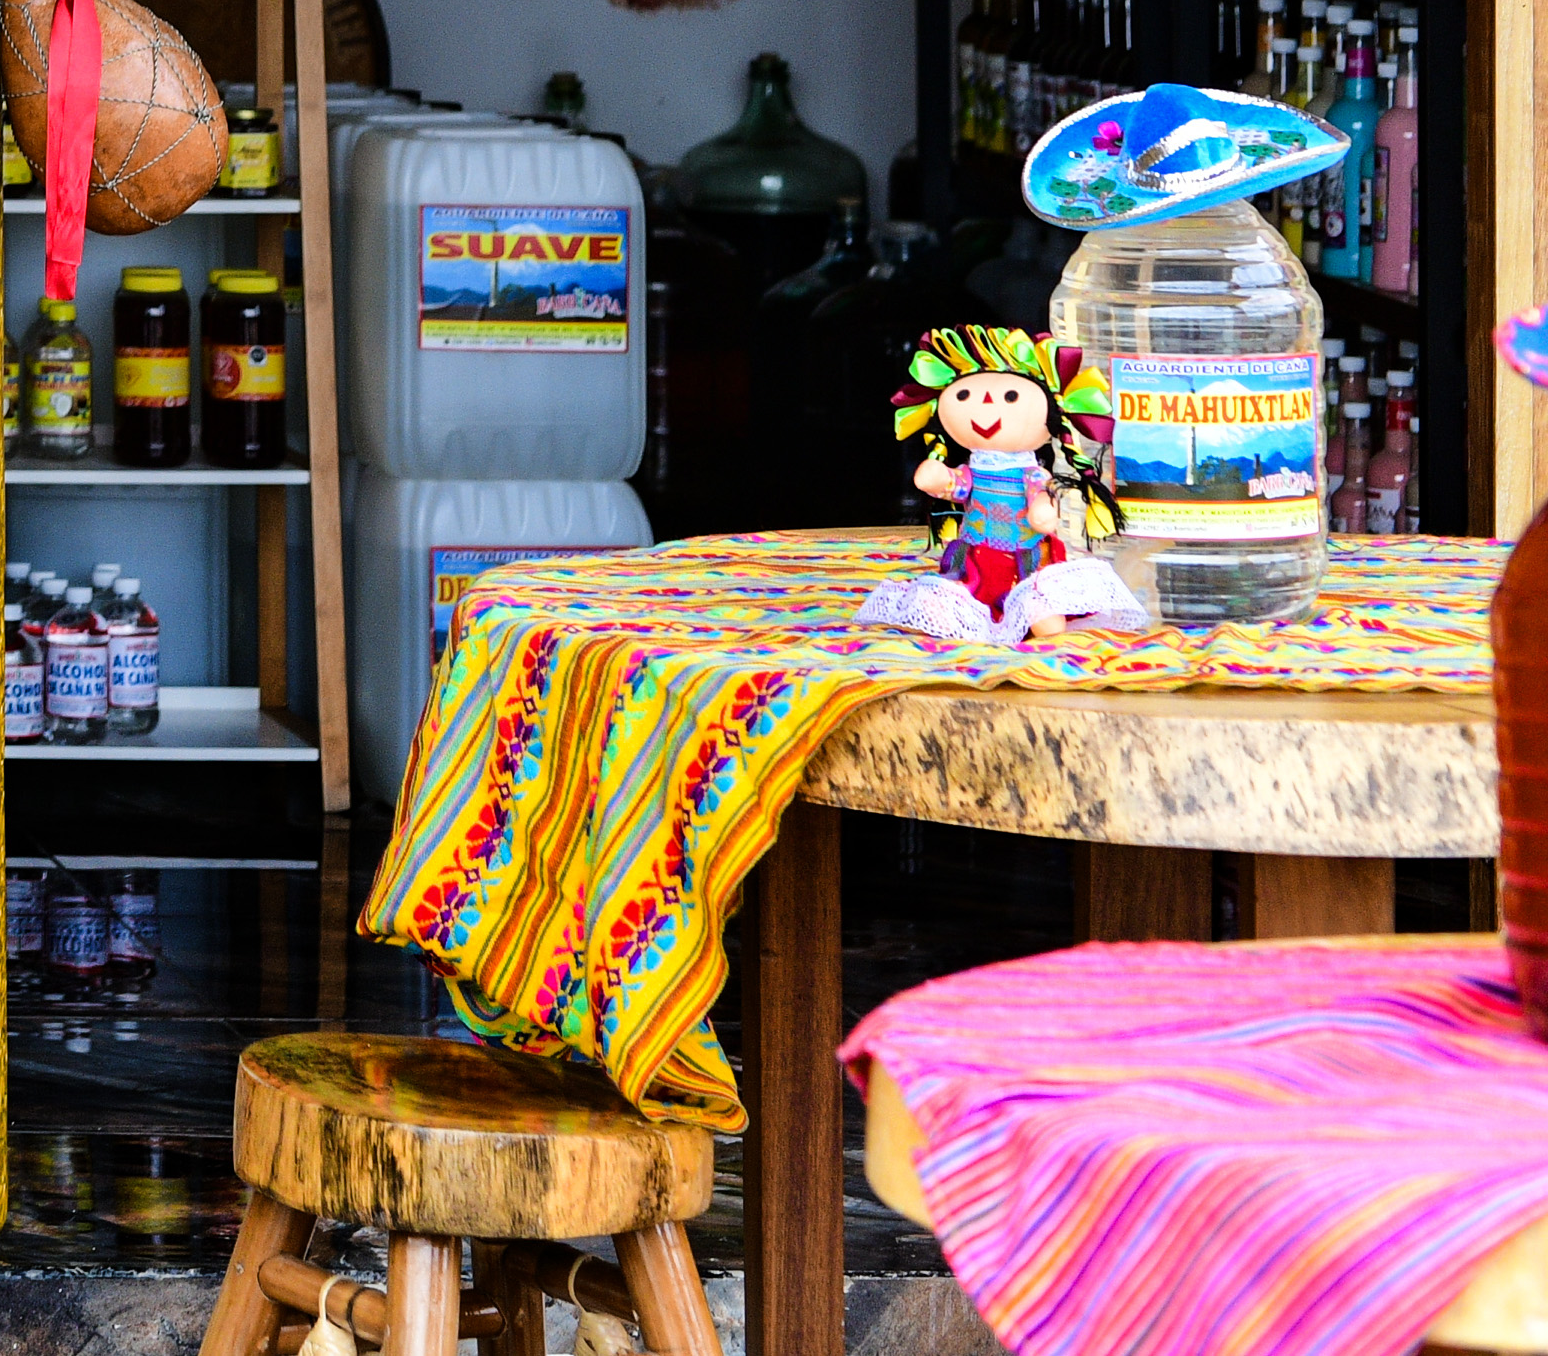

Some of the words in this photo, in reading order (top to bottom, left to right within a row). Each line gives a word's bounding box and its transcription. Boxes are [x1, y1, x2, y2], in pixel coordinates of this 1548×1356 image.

[429, 233, 621, 262] SUAVE
[1122, 361, 1247, 375] AGUARDIENTE
[1253, 361, 1273, 374] DE
[1276, 358, 1309, 373] CAÑA
[1119, 392, 1152, 422] DE
[1159, 391, 1312, 424] MAHUIXTLAN
